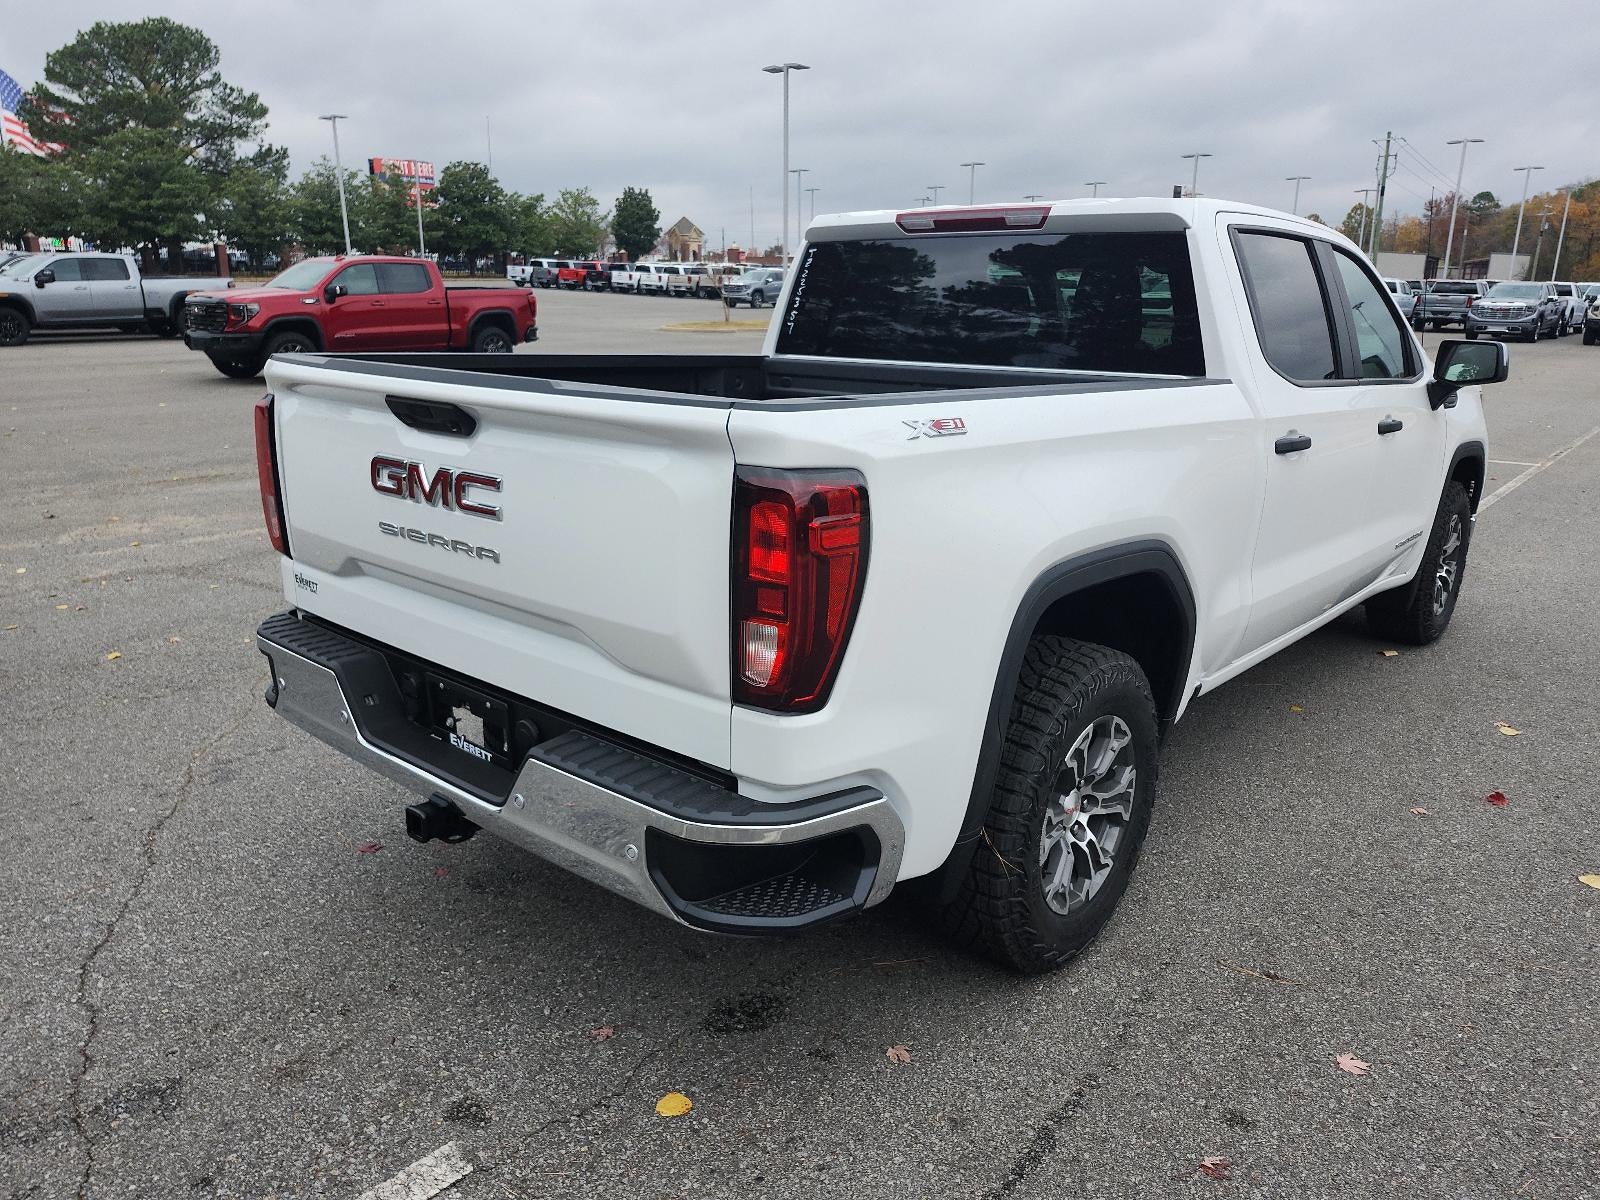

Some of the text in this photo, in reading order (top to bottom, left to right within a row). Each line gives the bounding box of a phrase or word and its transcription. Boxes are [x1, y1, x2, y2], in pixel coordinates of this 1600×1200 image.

[370, 452, 503, 522] GMC
[378, 521, 500, 564] SIERRA
[449, 732, 493, 762] EVERETT
